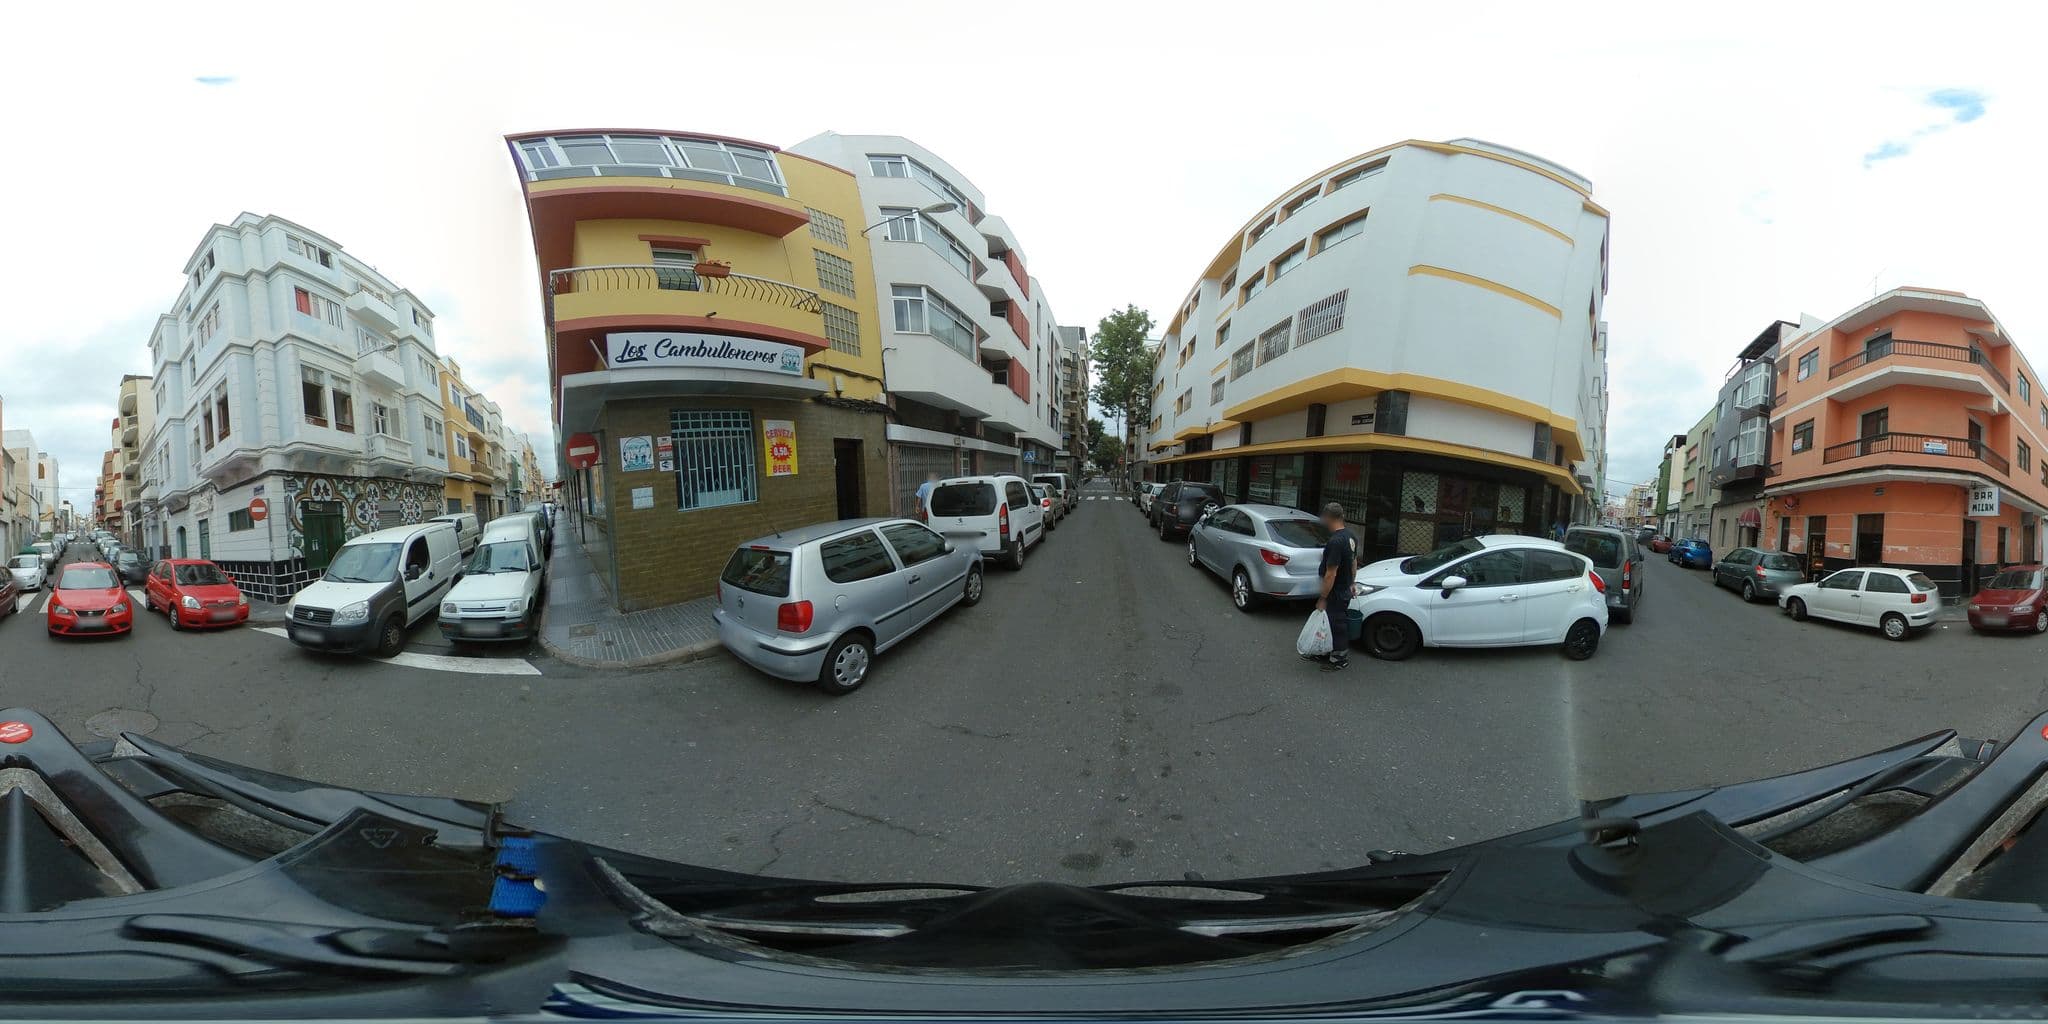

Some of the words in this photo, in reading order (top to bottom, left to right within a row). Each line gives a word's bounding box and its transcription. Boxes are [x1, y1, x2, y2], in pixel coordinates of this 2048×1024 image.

[615, 339, 648, 363] Los
[654, 338, 778, 363] Cambulloneros
[766, 428, 793, 440] CERVEZA
[772, 465, 792, 473] BEER
[1974, 491, 1993, 500] BAR
[1972, 503, 1994, 512] MILAN
